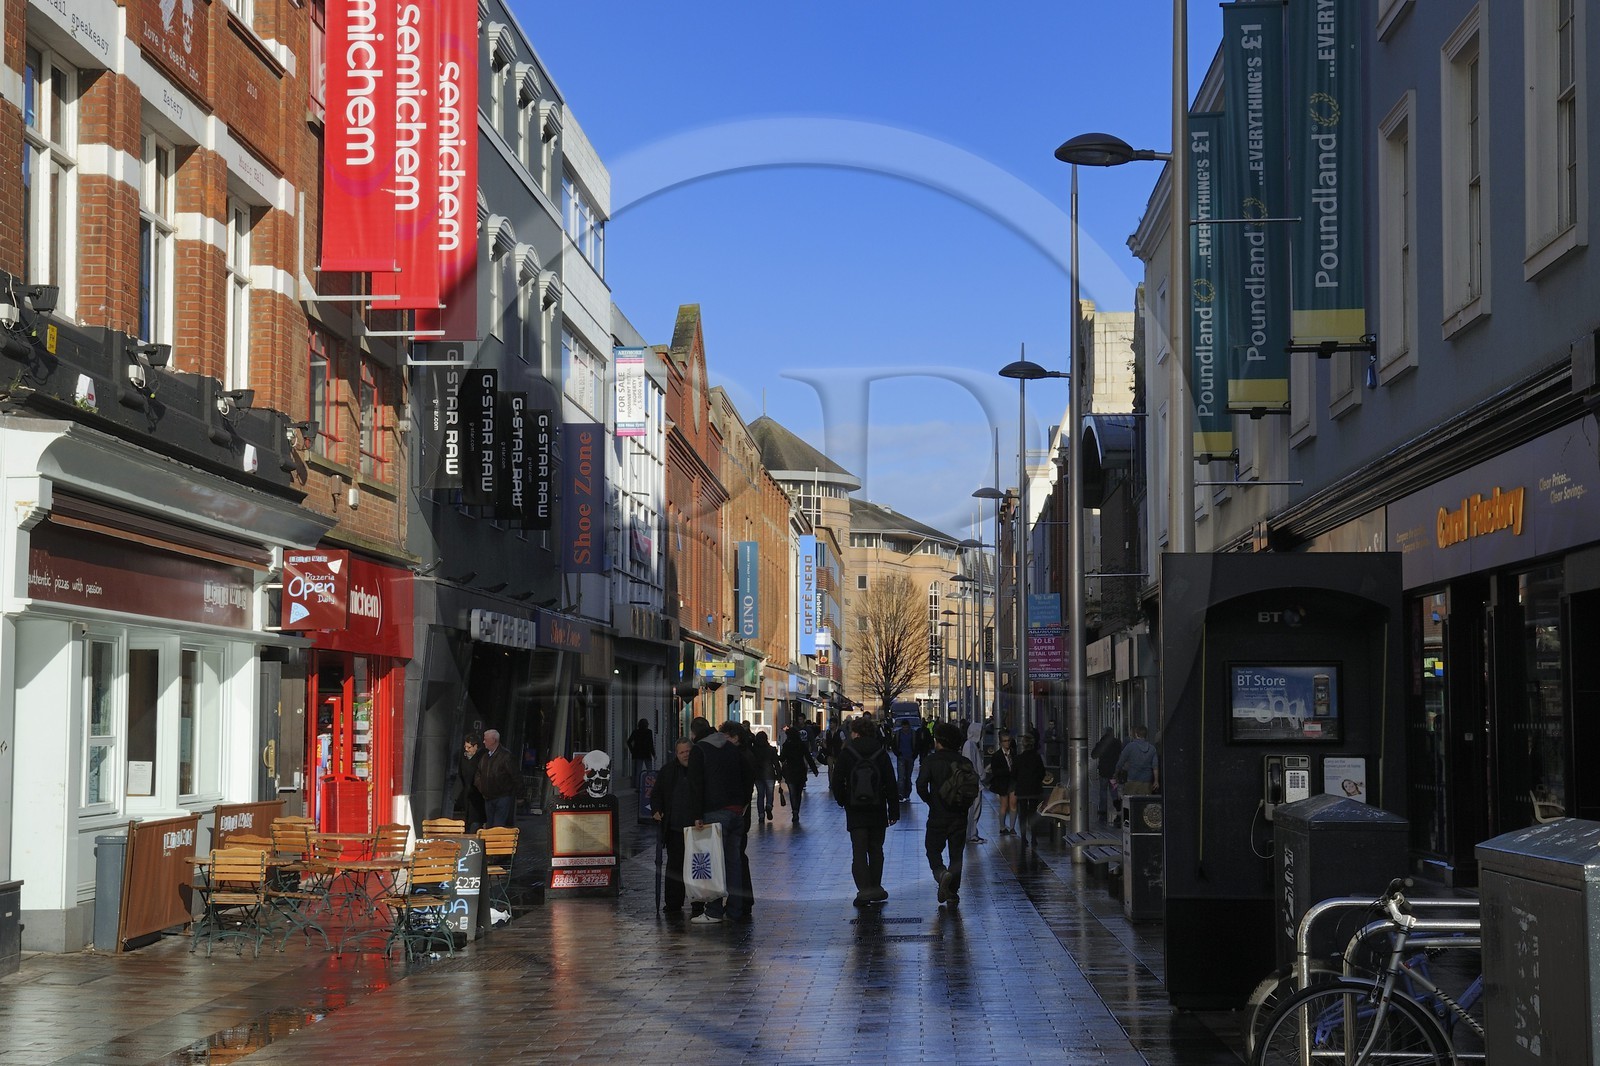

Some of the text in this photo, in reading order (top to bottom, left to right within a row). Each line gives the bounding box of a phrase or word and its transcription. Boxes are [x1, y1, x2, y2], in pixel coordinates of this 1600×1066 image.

[71, 13, 109, 56] speakeasy
[162, 39, 167, 53] &
[169, 46, 187, 71] death
[1241, 24, 1262, 50] £1
[163, 90, 184, 119] Eatery
[395, 4, 427, 210] semichem
[438, 61, 466, 250] semichem
[1191, 131, 1209, 152] £1
[1311, 133, 1338, 288] Poundland
[1244, 232, 1266, 361] Poundland
[1195, 306, 1214, 417] Poundland
[446, 350, 459, 475] G-STAR RAW
[618, 372, 626, 413] FOR SALE
[481, 375, 494, 492] G-STAR RAW
[512, 398, 523, 507] G-STAR RAW
[538, 415, 548, 518] G-STAR RAW
[574, 431, 592, 495] Zone
[573, 503, 592, 565] Shoe
[1437, 499, 1468, 549] Card
[1470, 486, 1525, 537] Factory
[28, 569, 103, 598] authentic pizzas with passion
[288, 576, 335, 601] Open
[305, 572, 335, 581] Pizzeria
[318, 595, 335, 605] Daily
[743, 596, 754, 635] GINO
[1257, 611, 1282, 623] BT
[551, 619, 581, 647] Shoe Zone
[1237, 675, 1286, 686] BT Store
